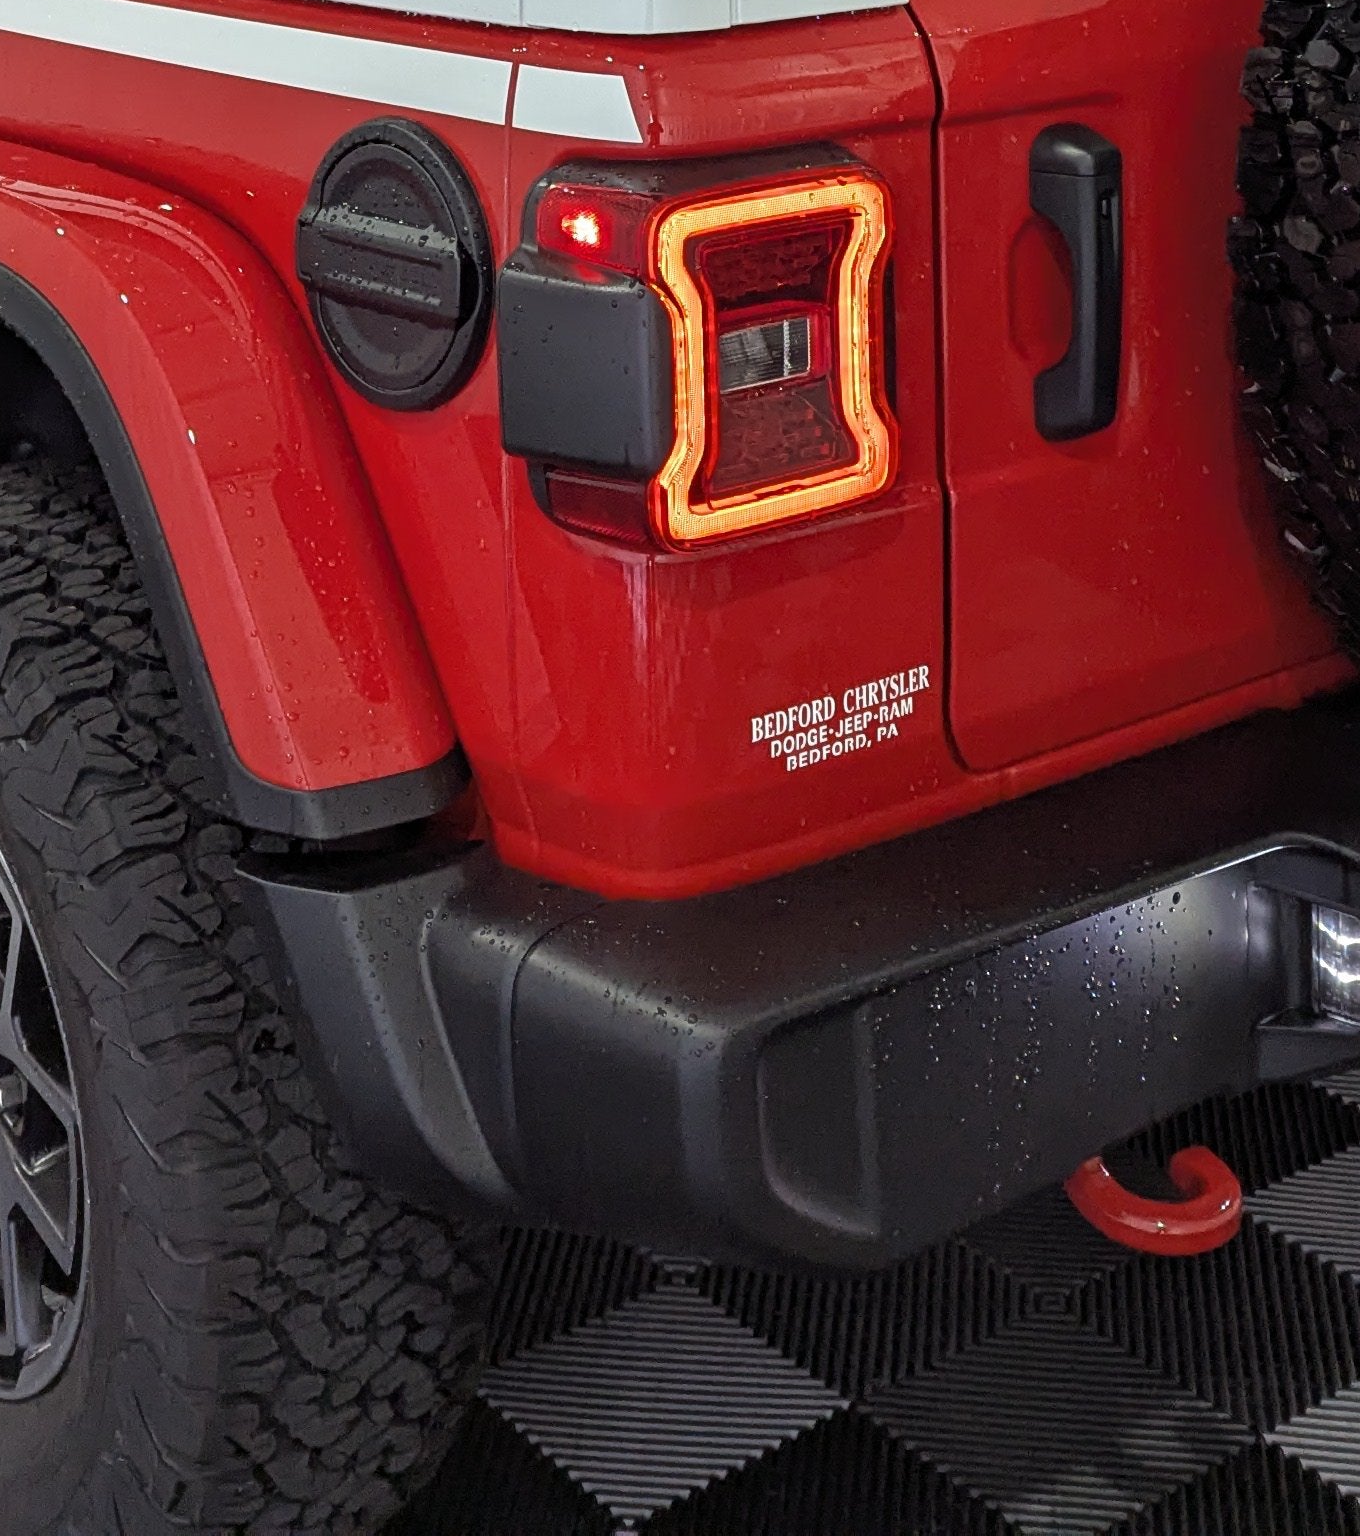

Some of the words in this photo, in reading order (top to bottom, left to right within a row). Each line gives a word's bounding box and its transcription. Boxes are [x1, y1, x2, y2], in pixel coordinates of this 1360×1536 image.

[751, 695, 836, 744] BEDFORD
[843, 665, 930, 714] CHRYSLER
[786, 733, 872, 772] BEDFORD,
[876, 723, 899, 742] PA
